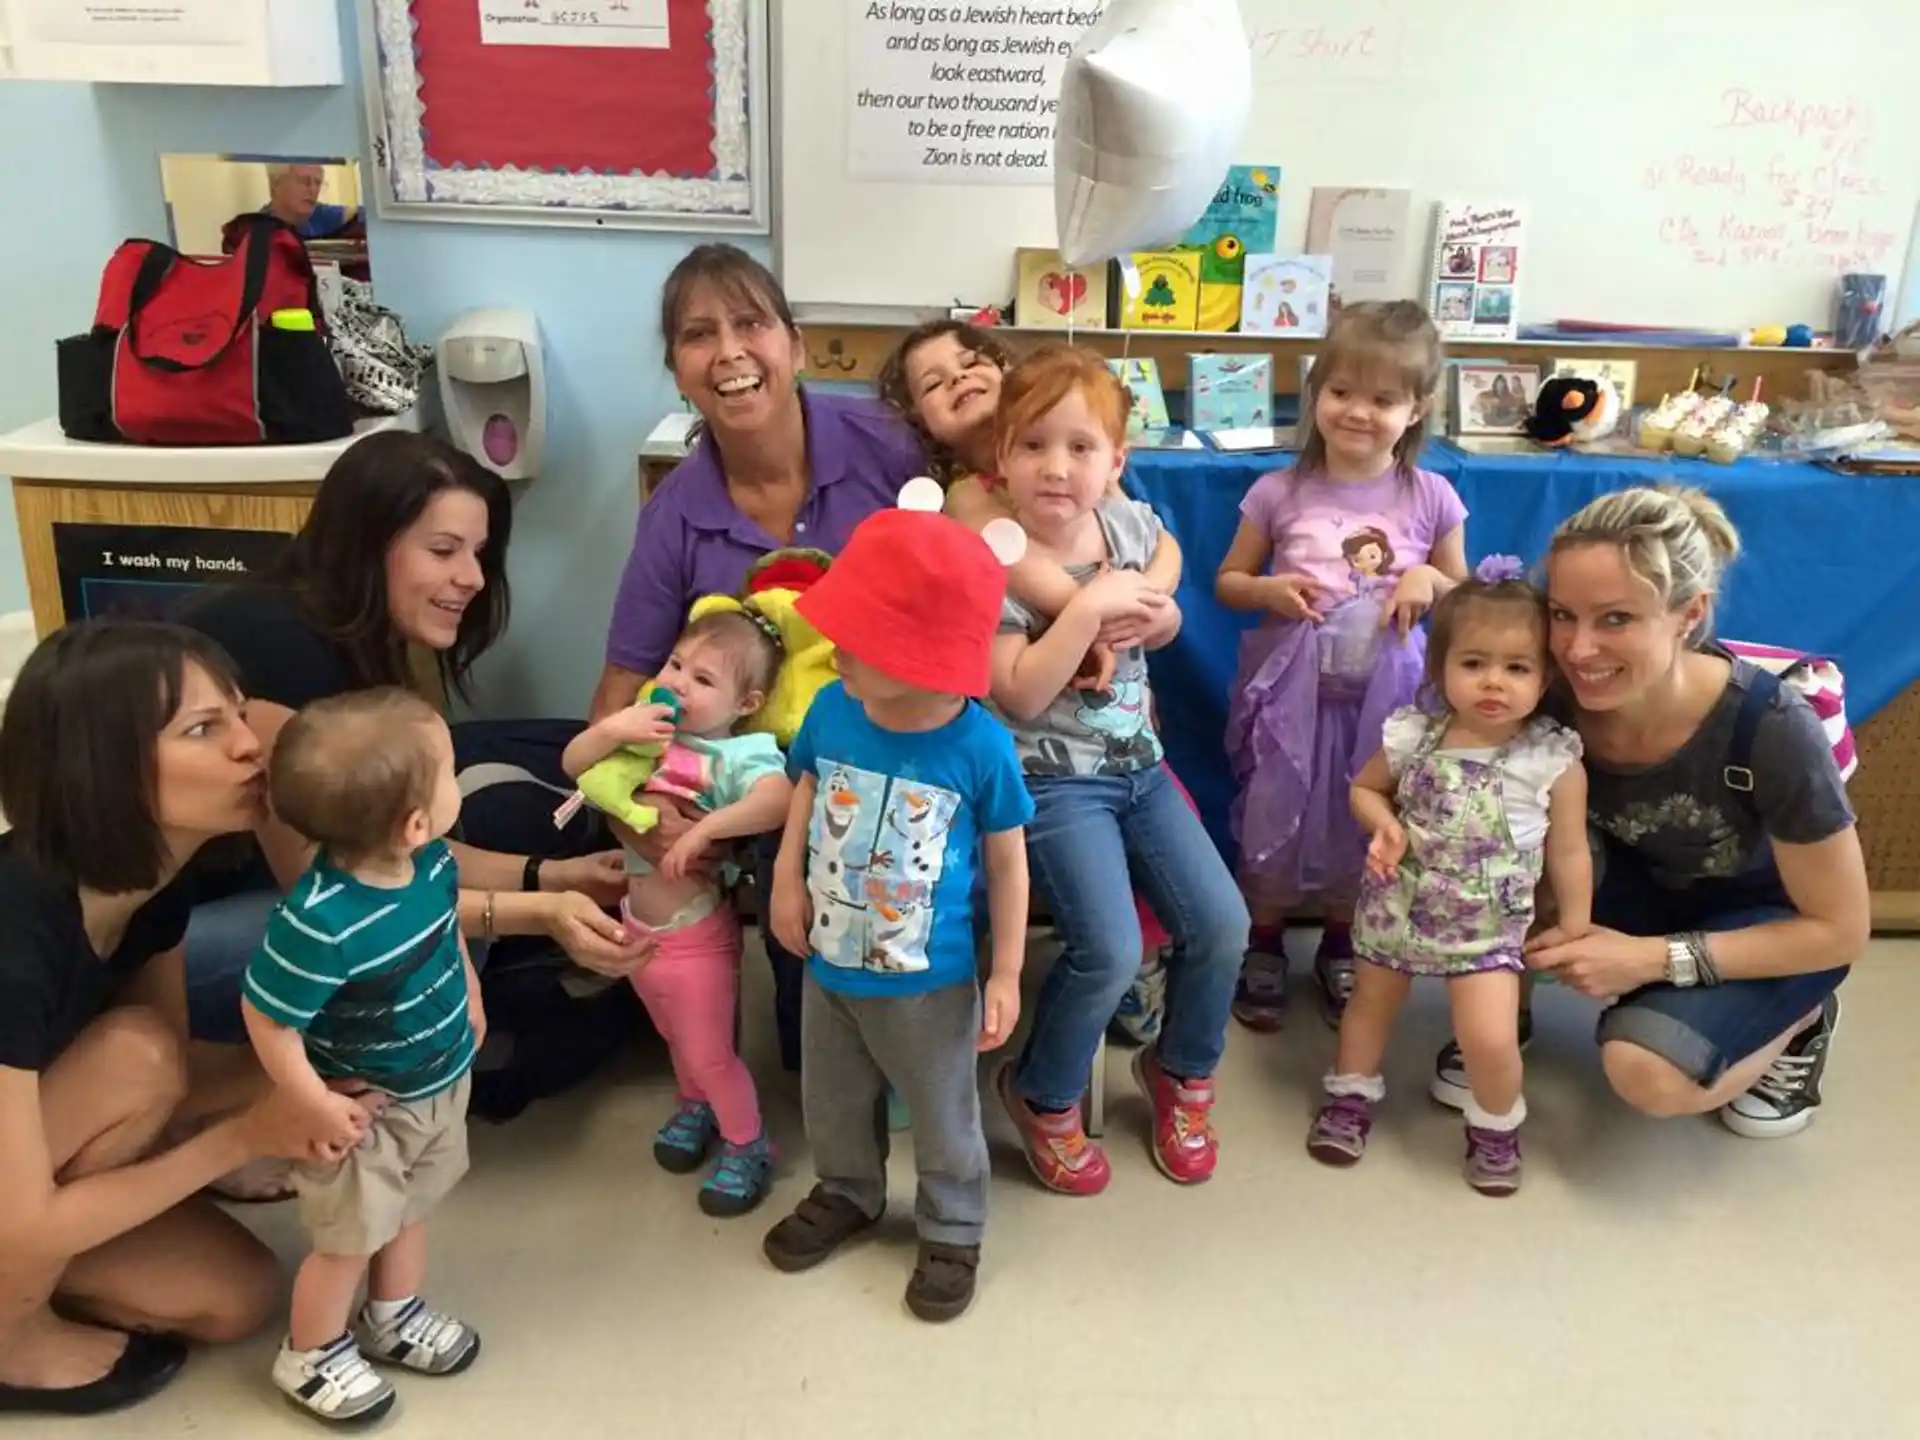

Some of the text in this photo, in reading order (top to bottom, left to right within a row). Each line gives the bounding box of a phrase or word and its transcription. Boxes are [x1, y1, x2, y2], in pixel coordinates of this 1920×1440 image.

[866, 1, 1102, 27] As long as a Jewish heart bea
[886, 32, 921, 50] and
[921, 37, 941, 52] as
[942, 33, 979, 58] long
[980, 39, 1000, 53] as
[1001, 36, 1056, 55] Jewish
[930, 61, 1047, 87] look eastward,
[857, 87, 894, 109] then
[896, 94, 926, 110] our
[928, 92, 960, 110] two
[961, 91, 1039, 112] thousand
[907, 120, 925, 137] to
[926, 118, 948, 138] be
[950, 122, 961, 138] a
[962, 119, 996, 142] free
[998, 121, 1050, 140] nation
[922, 147, 1048, 168] Zion is not dead.
[102, 551, 248, 573] I wash my hands.
